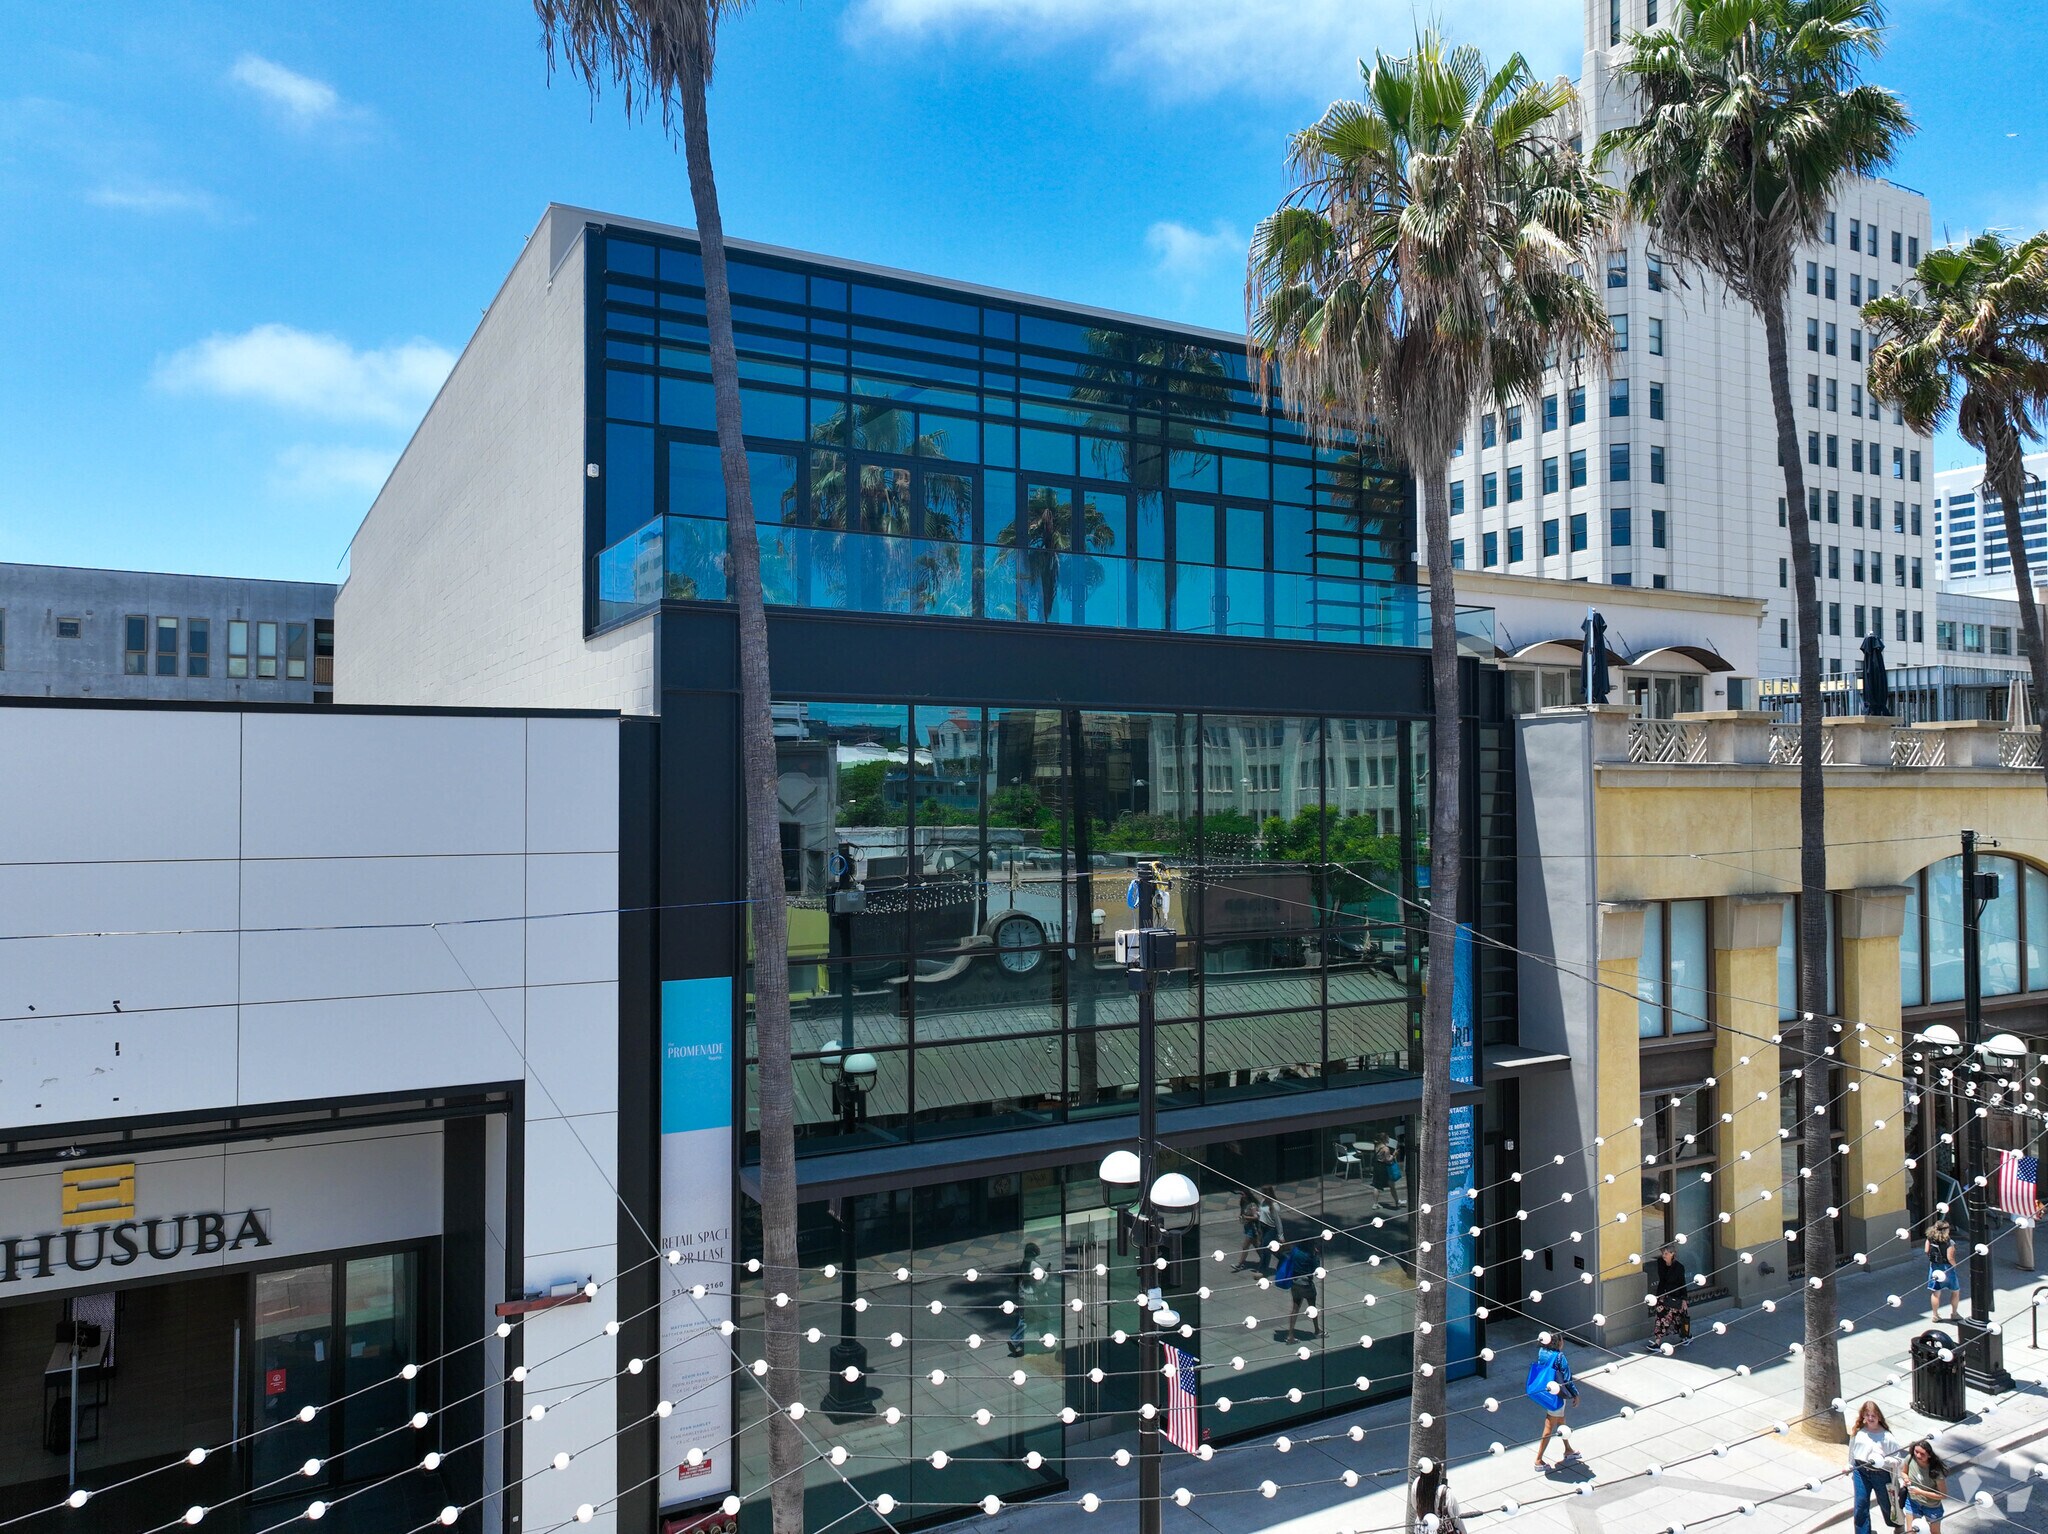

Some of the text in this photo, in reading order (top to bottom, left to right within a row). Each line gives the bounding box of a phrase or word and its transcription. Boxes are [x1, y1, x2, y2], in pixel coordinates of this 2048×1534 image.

[667, 1043, 724, 1059] PROMENADE
[1451, 1075, 1474, 1083] EASE
[662, 1228, 730, 1249] RETAIL SPACE
[697, 1247, 725, 1262] LEASE
[705, 1281, 724, 1290] 2160
